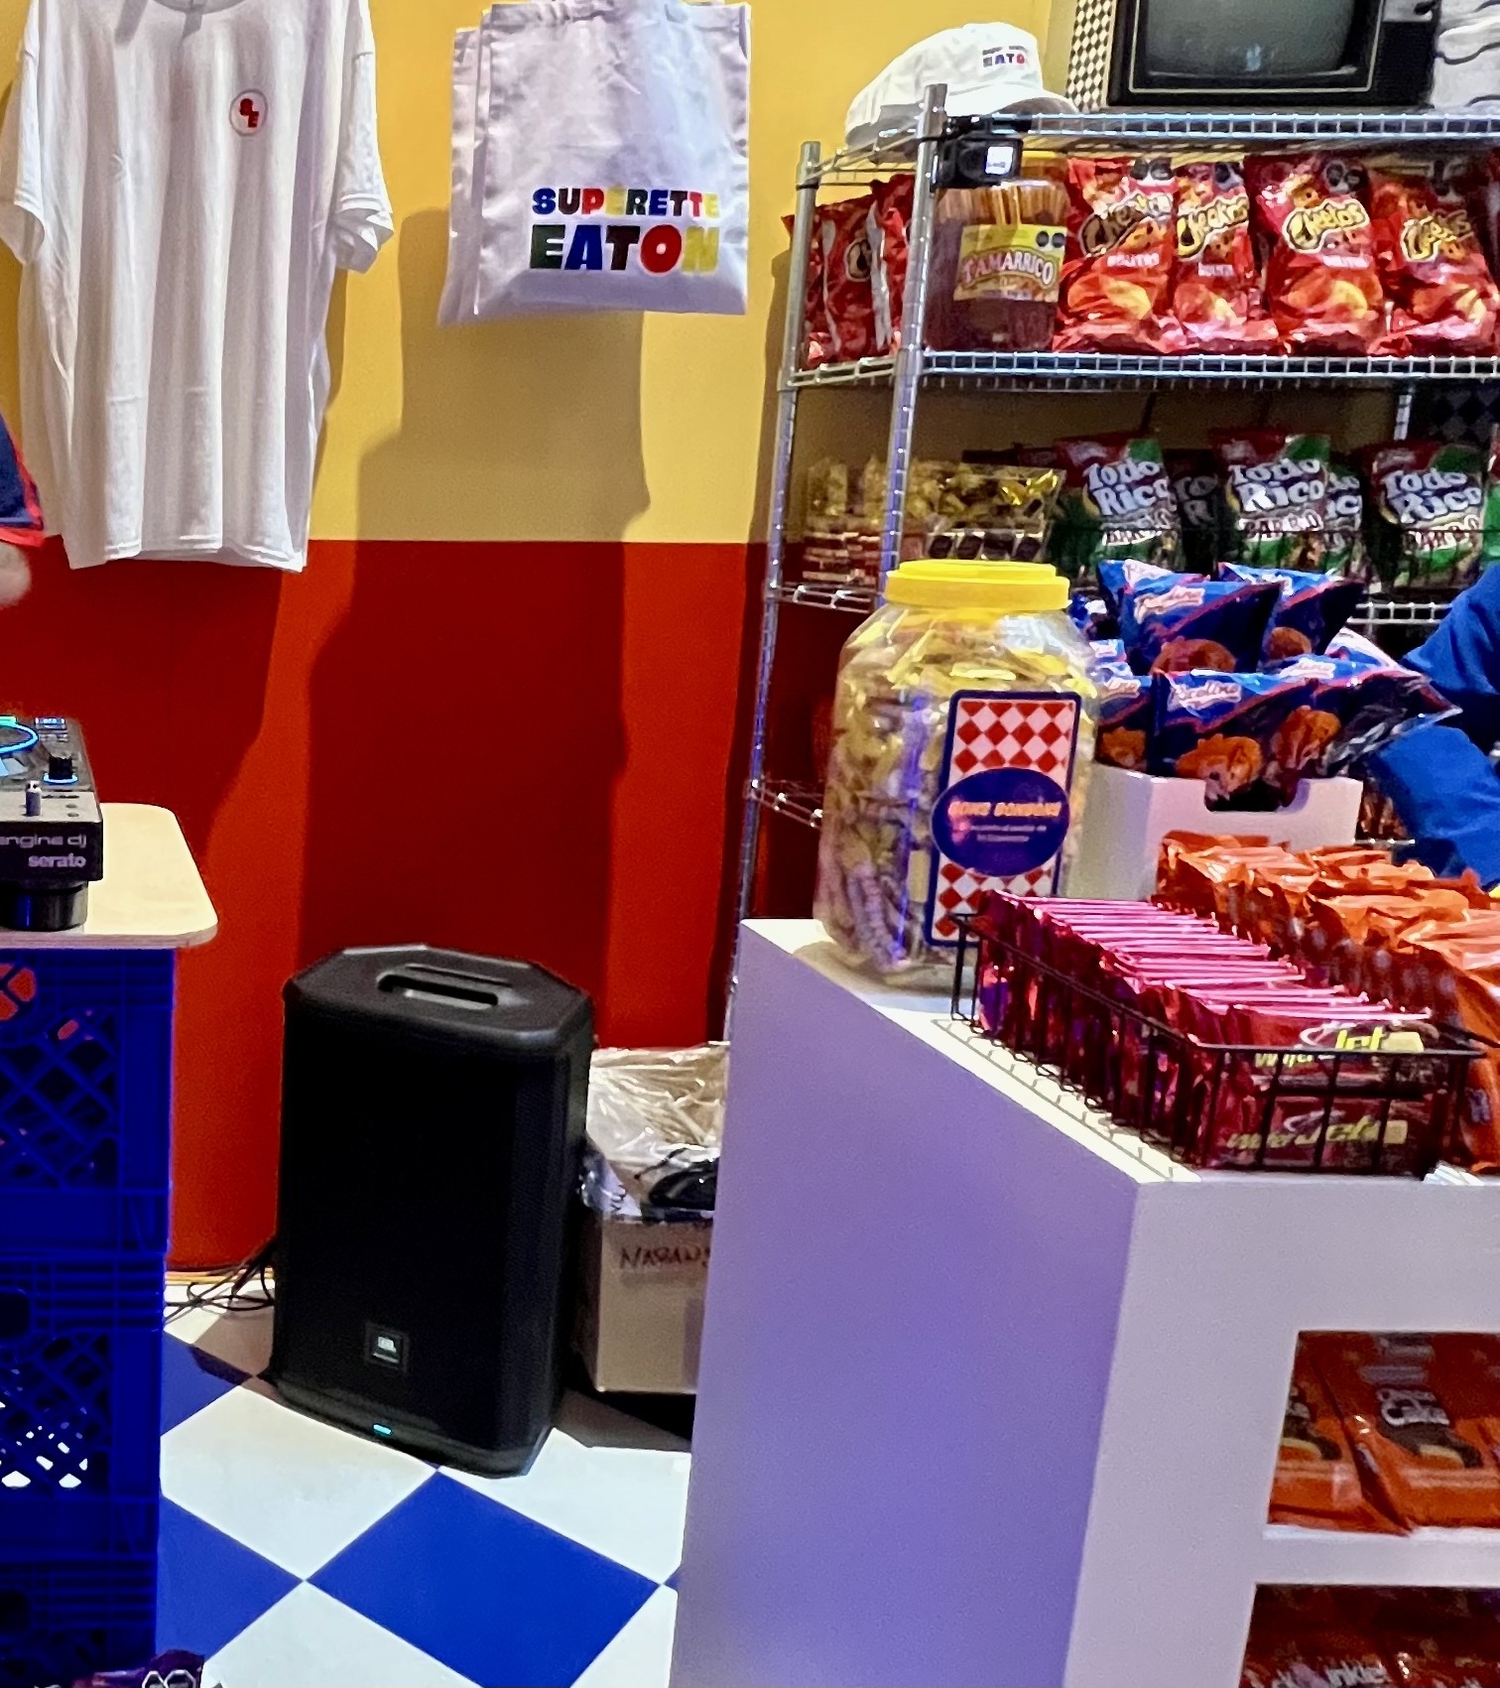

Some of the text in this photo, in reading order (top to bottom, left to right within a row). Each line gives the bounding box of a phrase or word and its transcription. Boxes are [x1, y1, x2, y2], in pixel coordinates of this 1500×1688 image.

[529, 223, 720, 275] EATON
[962, 250, 1055, 287] TAMARRICO
[1083, 458, 1161, 491] Todo
[1228, 458, 1321, 486] Todo
[1384, 468, 1468, 500] Todo
[1235, 479, 1325, 513] Rico
[1389, 486, 1483, 526] Rico
[28, 852, 87, 868] serato
